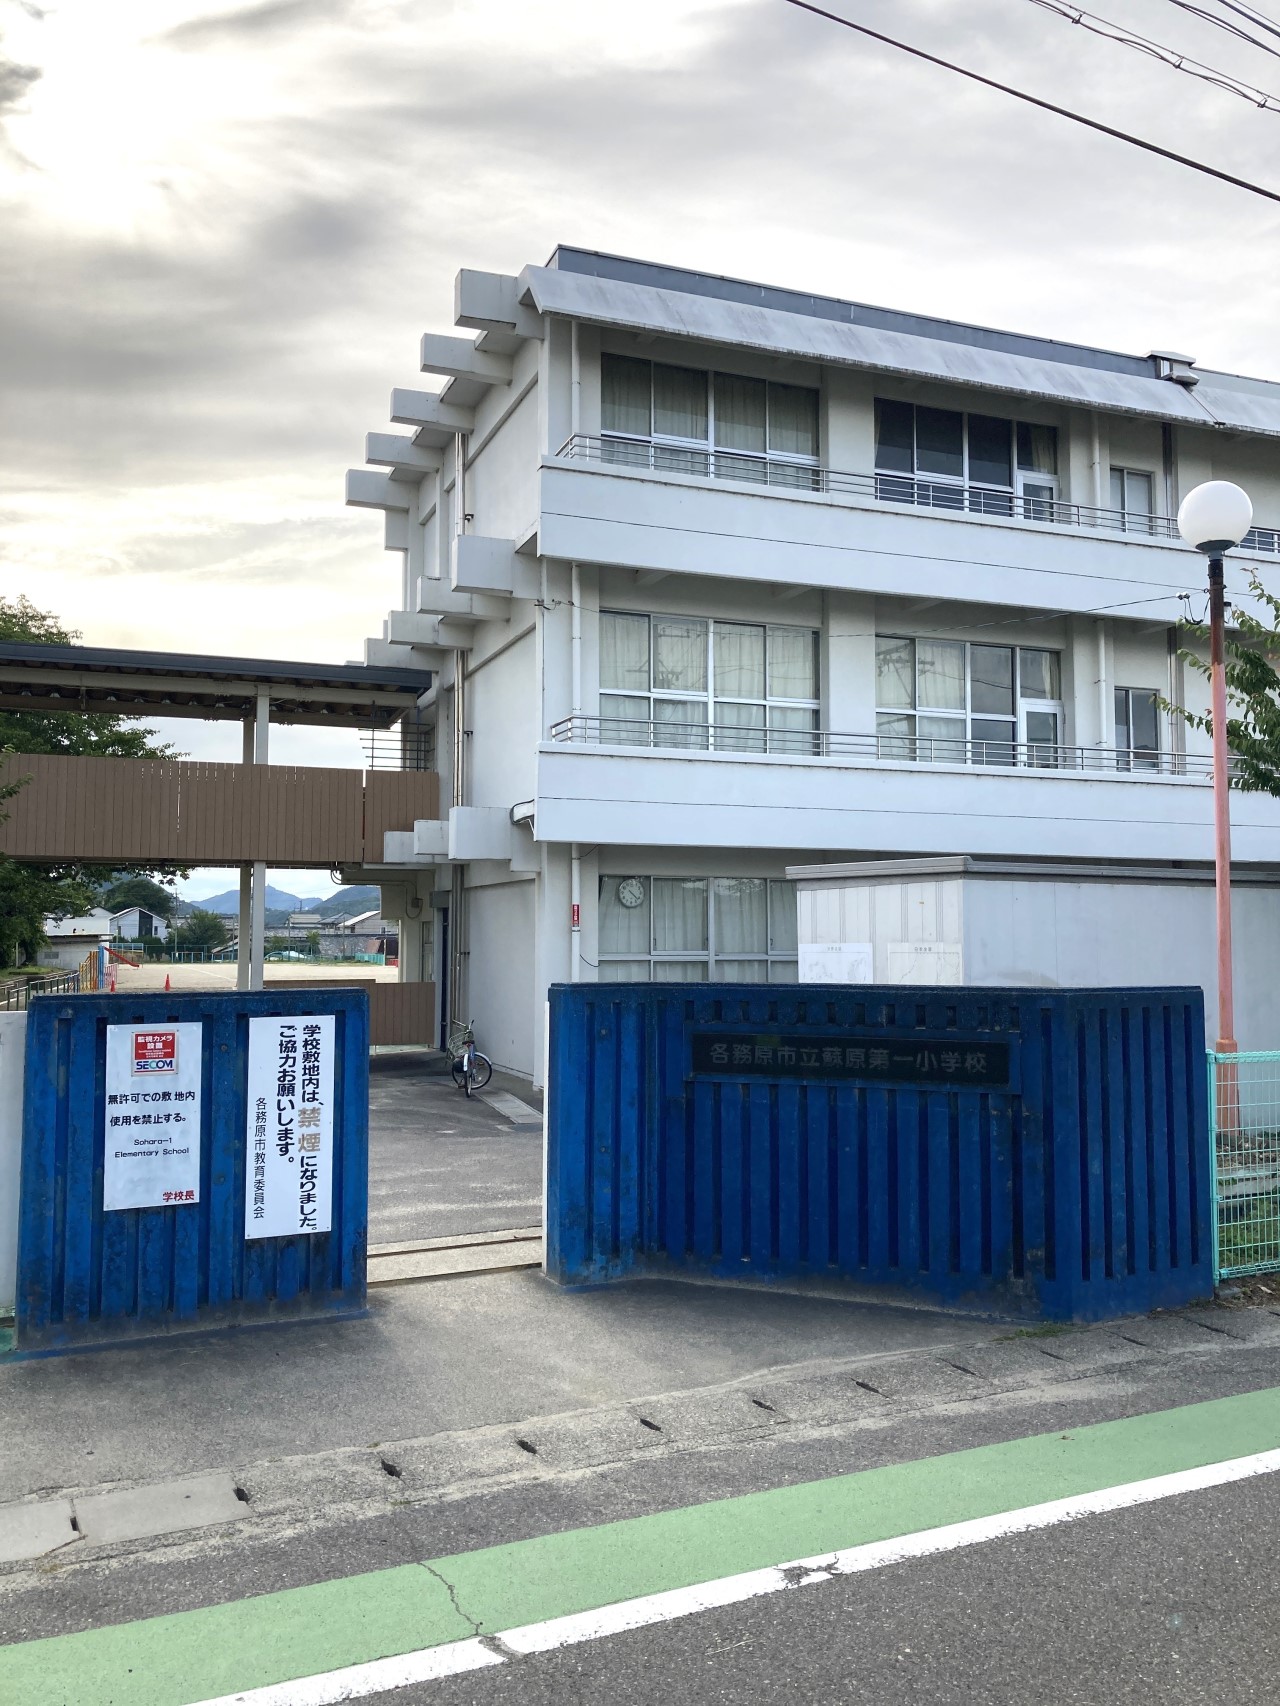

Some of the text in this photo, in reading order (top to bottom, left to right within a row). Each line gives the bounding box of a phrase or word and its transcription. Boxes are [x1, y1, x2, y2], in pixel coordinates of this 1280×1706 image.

[136, 1060, 173, 1070] SECOM
[709, 1043, 987, 1073] 各務原市立蘇原第一小学校
[276, 1025, 298, 1163] ご協力お願いします。
[109, 1113, 187, 1127] 使用を禁止する。
[114, 1148, 190, 1159] Elementary School
[253, 1097, 267, 1219] 各務原市教育委員会
[162, 1190, 195, 1202] 学校長
